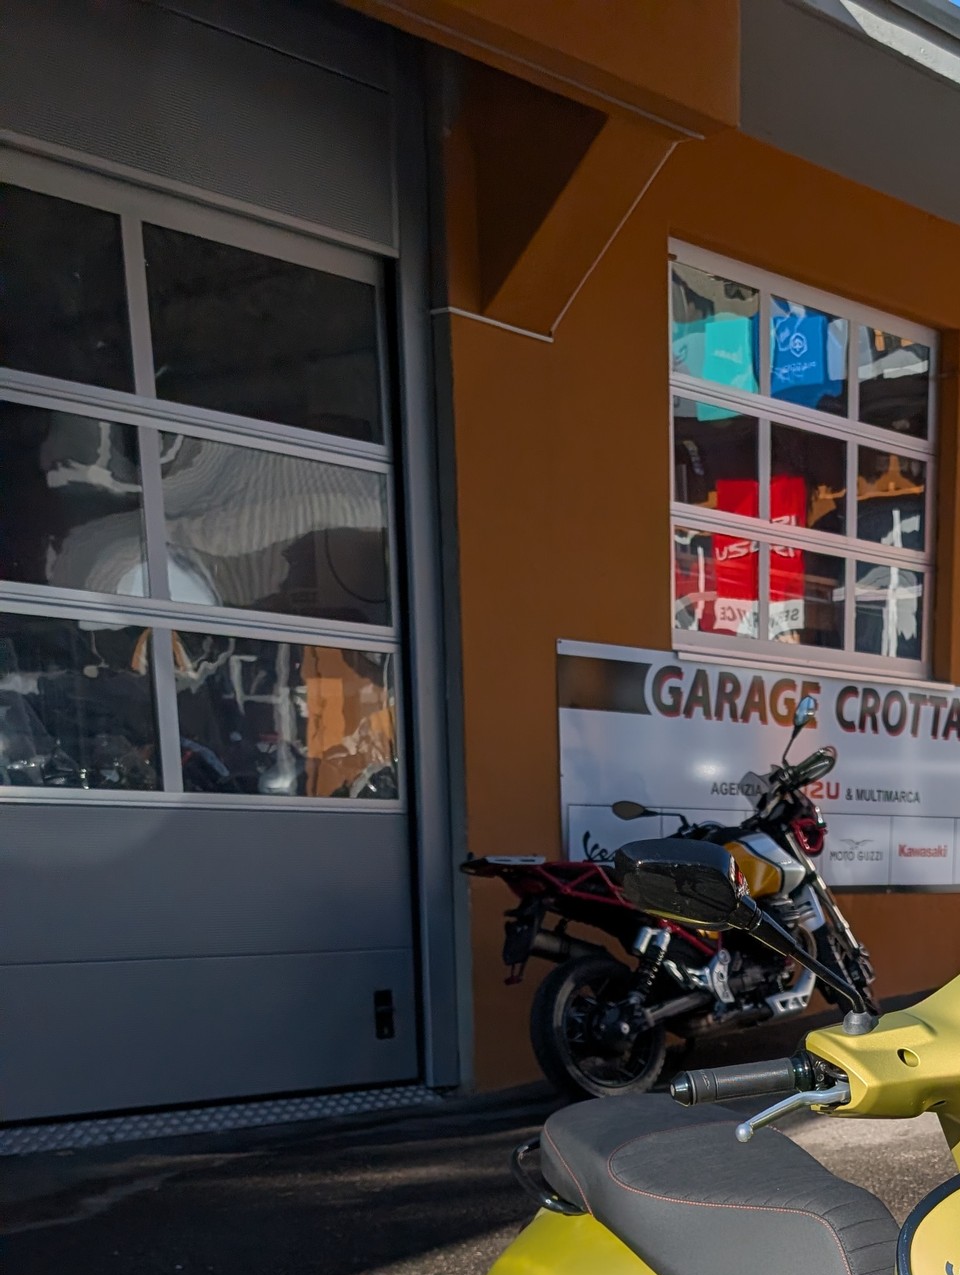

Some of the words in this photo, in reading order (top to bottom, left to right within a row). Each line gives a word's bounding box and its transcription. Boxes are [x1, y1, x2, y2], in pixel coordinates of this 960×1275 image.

[651, 665, 821, 729] GARAGE
[845, 787, 853, 801] &
[855, 788, 921, 804] MULTIMARCA
[829, 850, 853, 862] MOTO
[856, 851, 884, 863] GUZZI
[898, 843, 948, 859] Kawasaki
